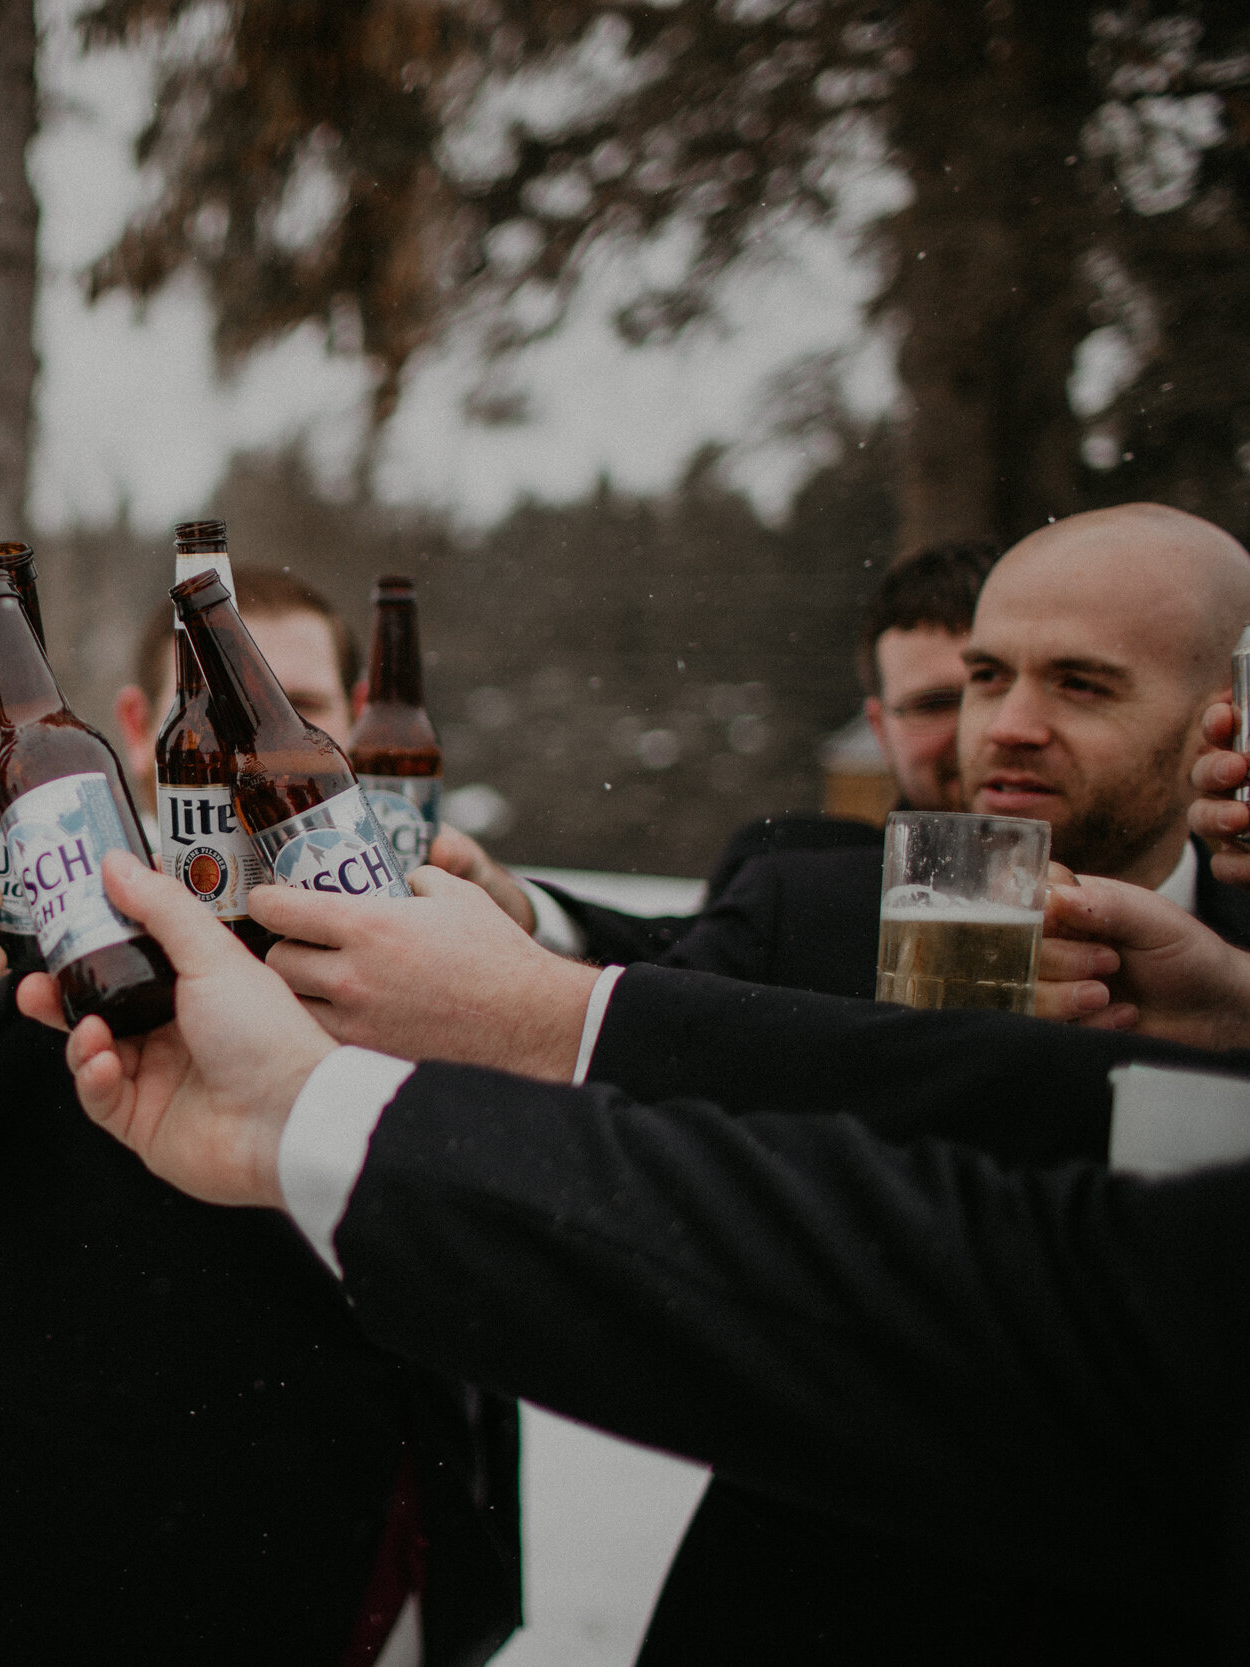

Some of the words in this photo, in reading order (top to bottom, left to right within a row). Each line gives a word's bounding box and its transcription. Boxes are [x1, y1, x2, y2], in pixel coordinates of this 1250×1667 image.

[168, 797, 237, 846] Lite
[22, 838, 94, 906] SCH
[201, 848, 226, 871] PILSNER
[301, 845, 394, 895] SCH
